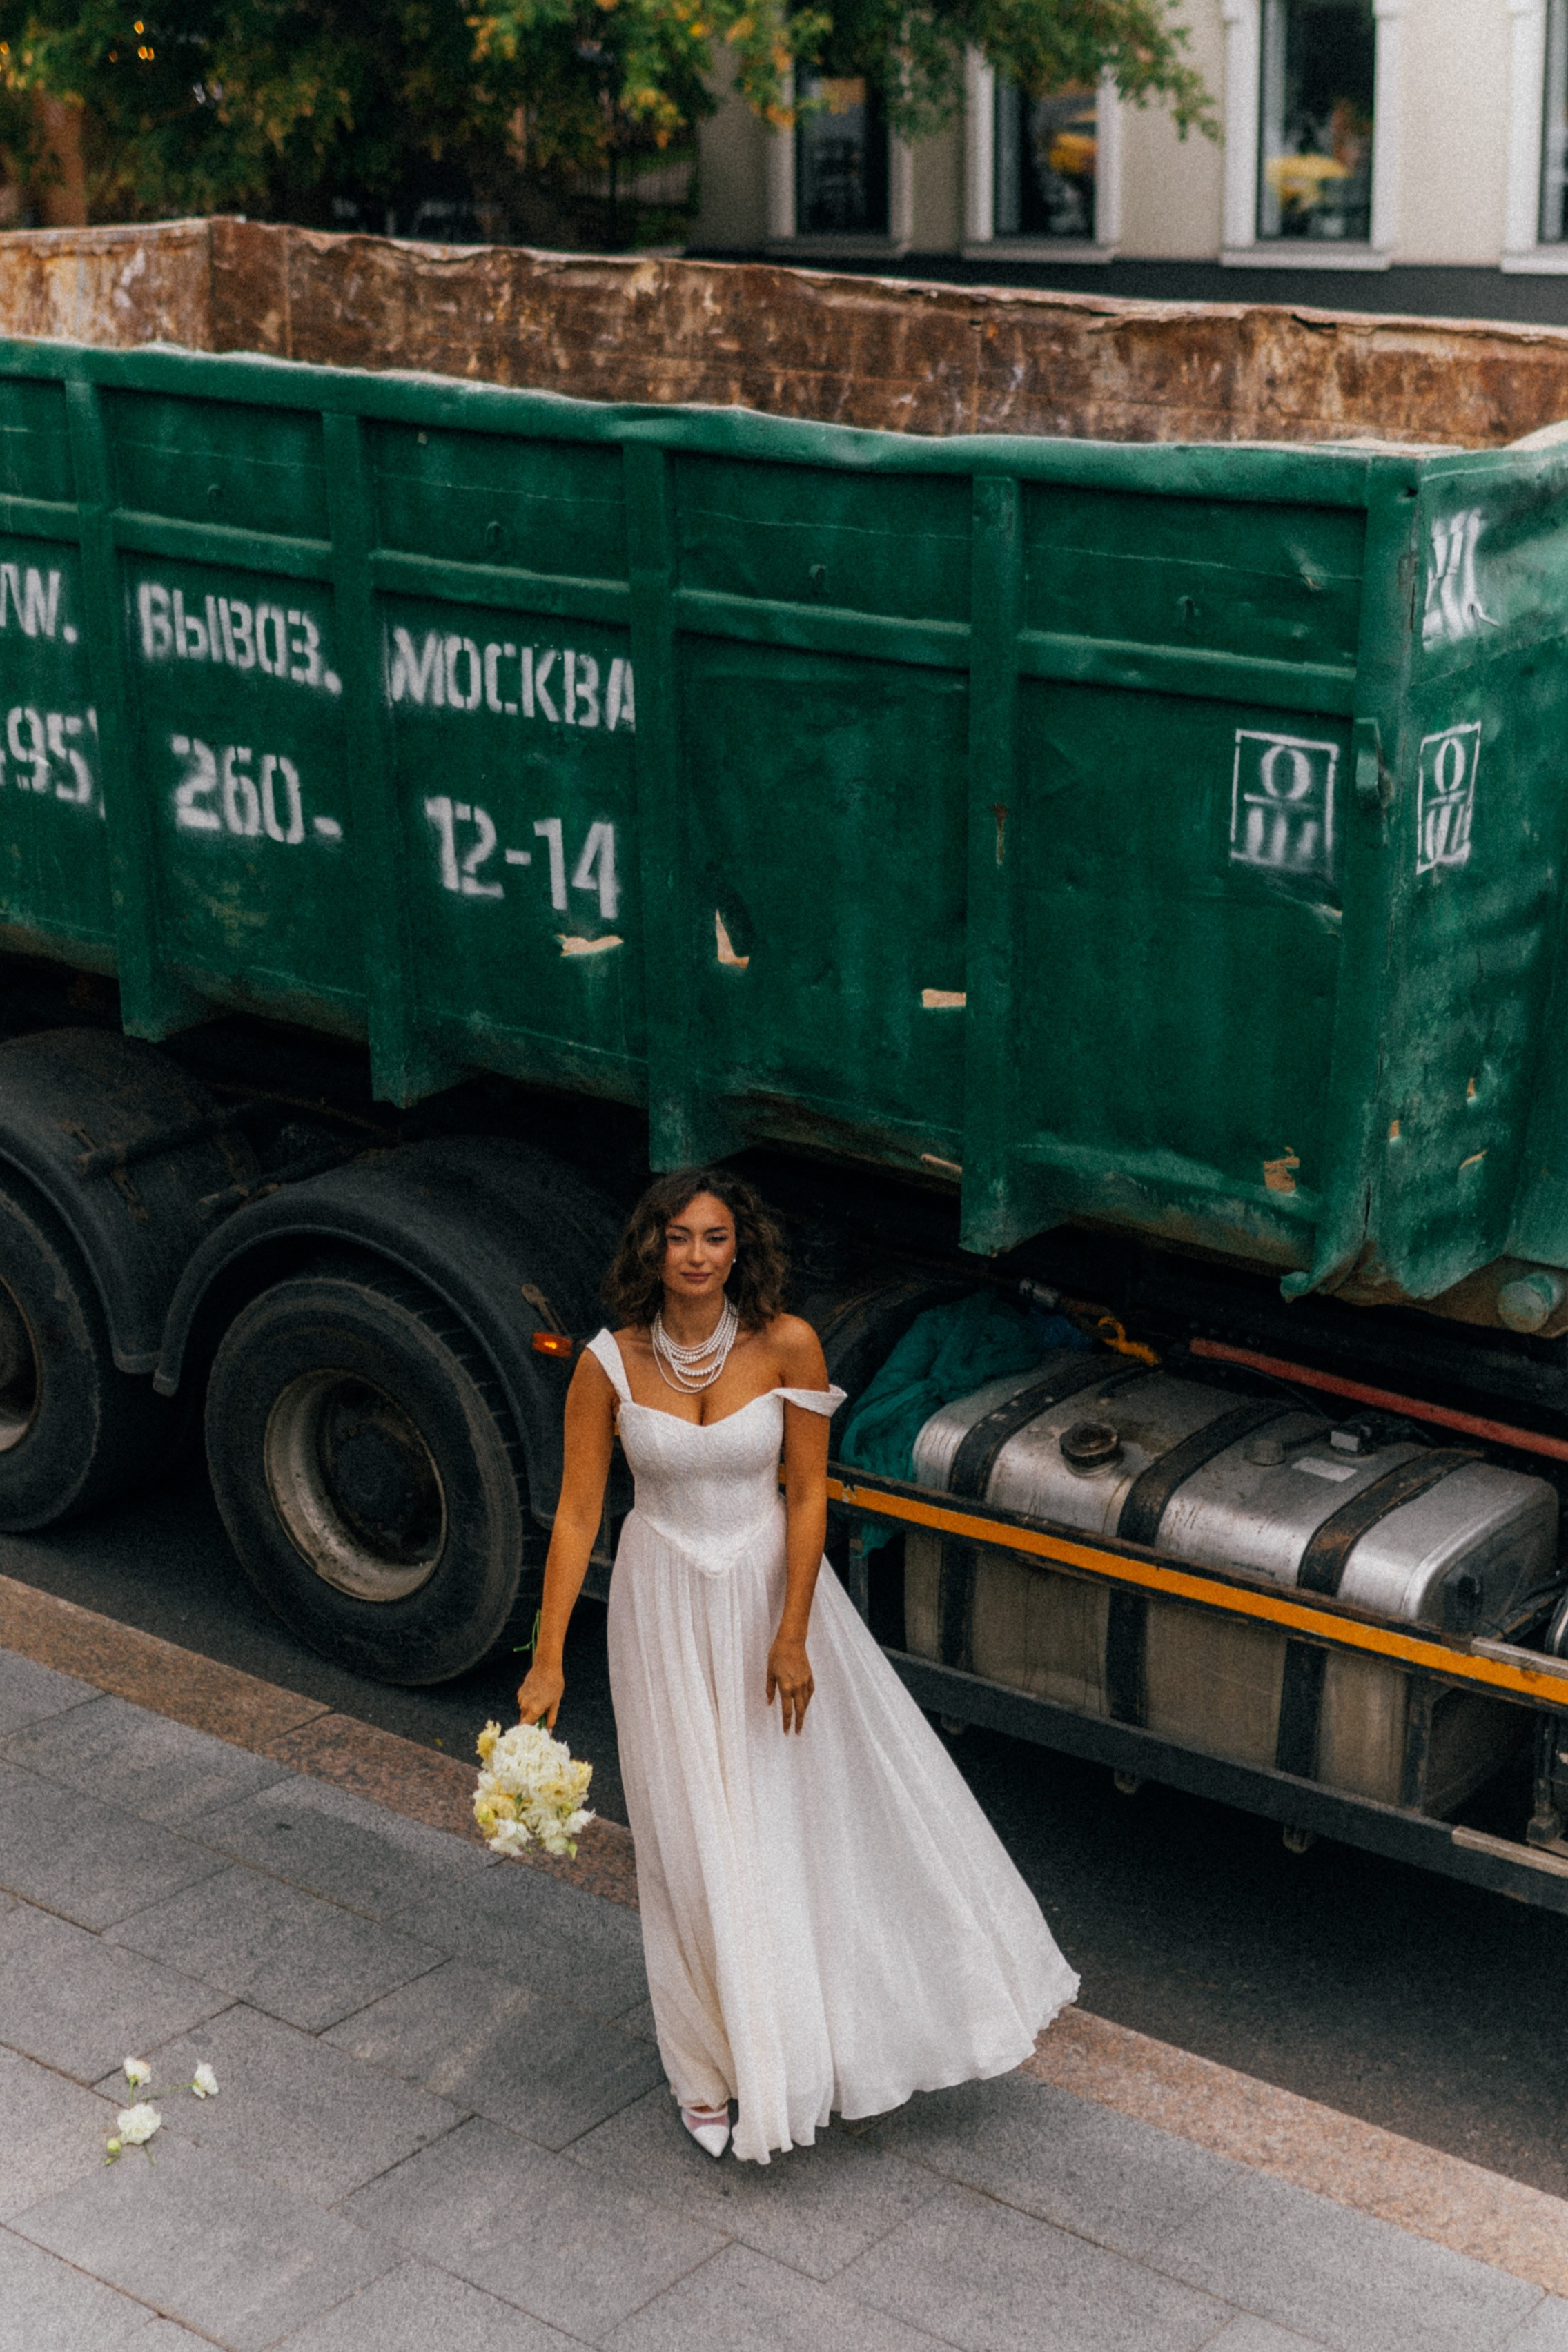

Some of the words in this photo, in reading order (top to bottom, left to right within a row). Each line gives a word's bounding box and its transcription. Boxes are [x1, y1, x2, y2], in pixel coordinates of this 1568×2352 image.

[138, 581, 342, 695] ВЫВОЗ.
[391, 624, 636, 732] МОСКВА
[424, 795, 620, 919] 12-14
